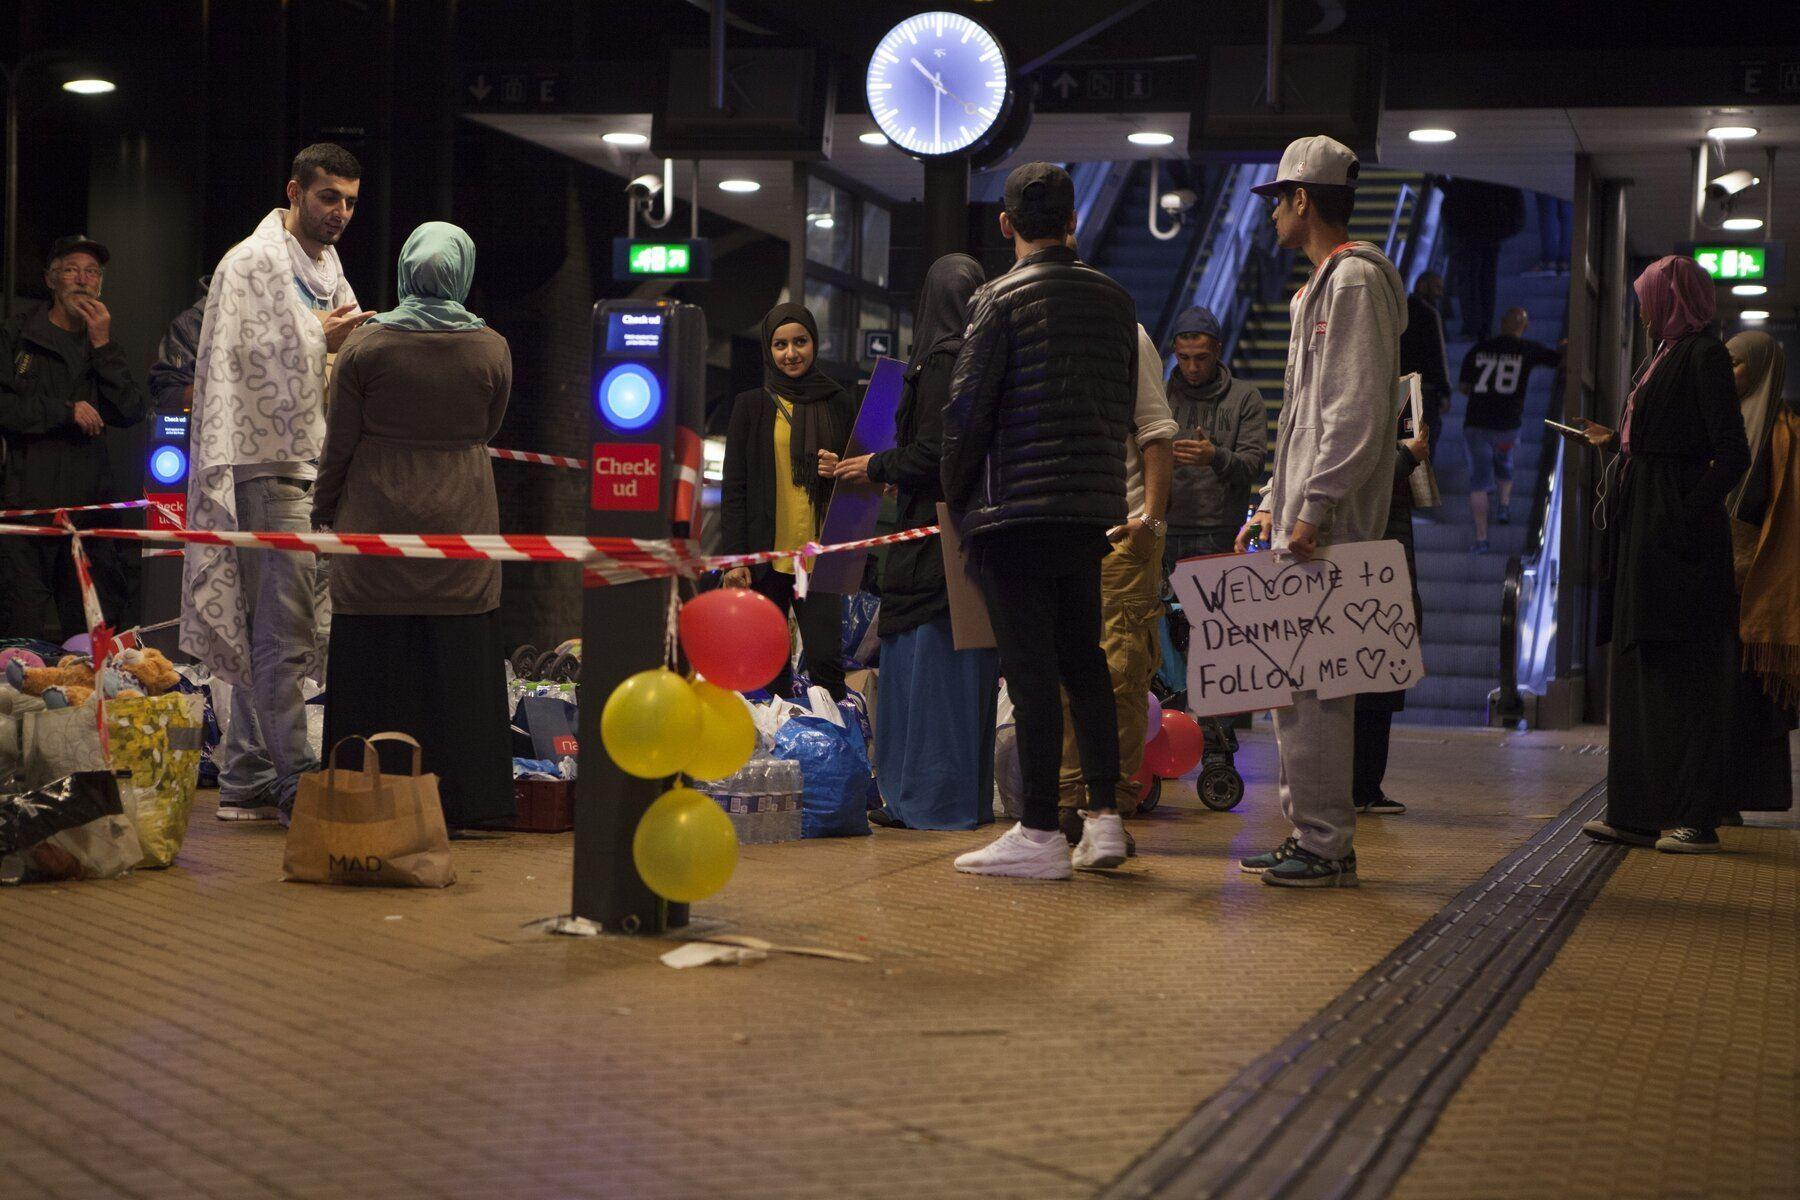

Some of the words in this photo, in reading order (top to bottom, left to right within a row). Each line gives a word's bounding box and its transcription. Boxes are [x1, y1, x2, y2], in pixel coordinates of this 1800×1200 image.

[1744, 68, 1761, 93] E
[1474, 355, 1523, 395] 78
[595, 456, 657, 475] Check
[612, 479, 638, 496] ud
[1192, 569, 1343, 612] WELCOME
[1359, 561, 1394, 587] to
[1202, 615, 1335, 650] DENMARK
[1200, 664, 1305, 698] FOLLOW
[1319, 658, 1348, 682] ME
[328, 854, 382, 873] MAD
